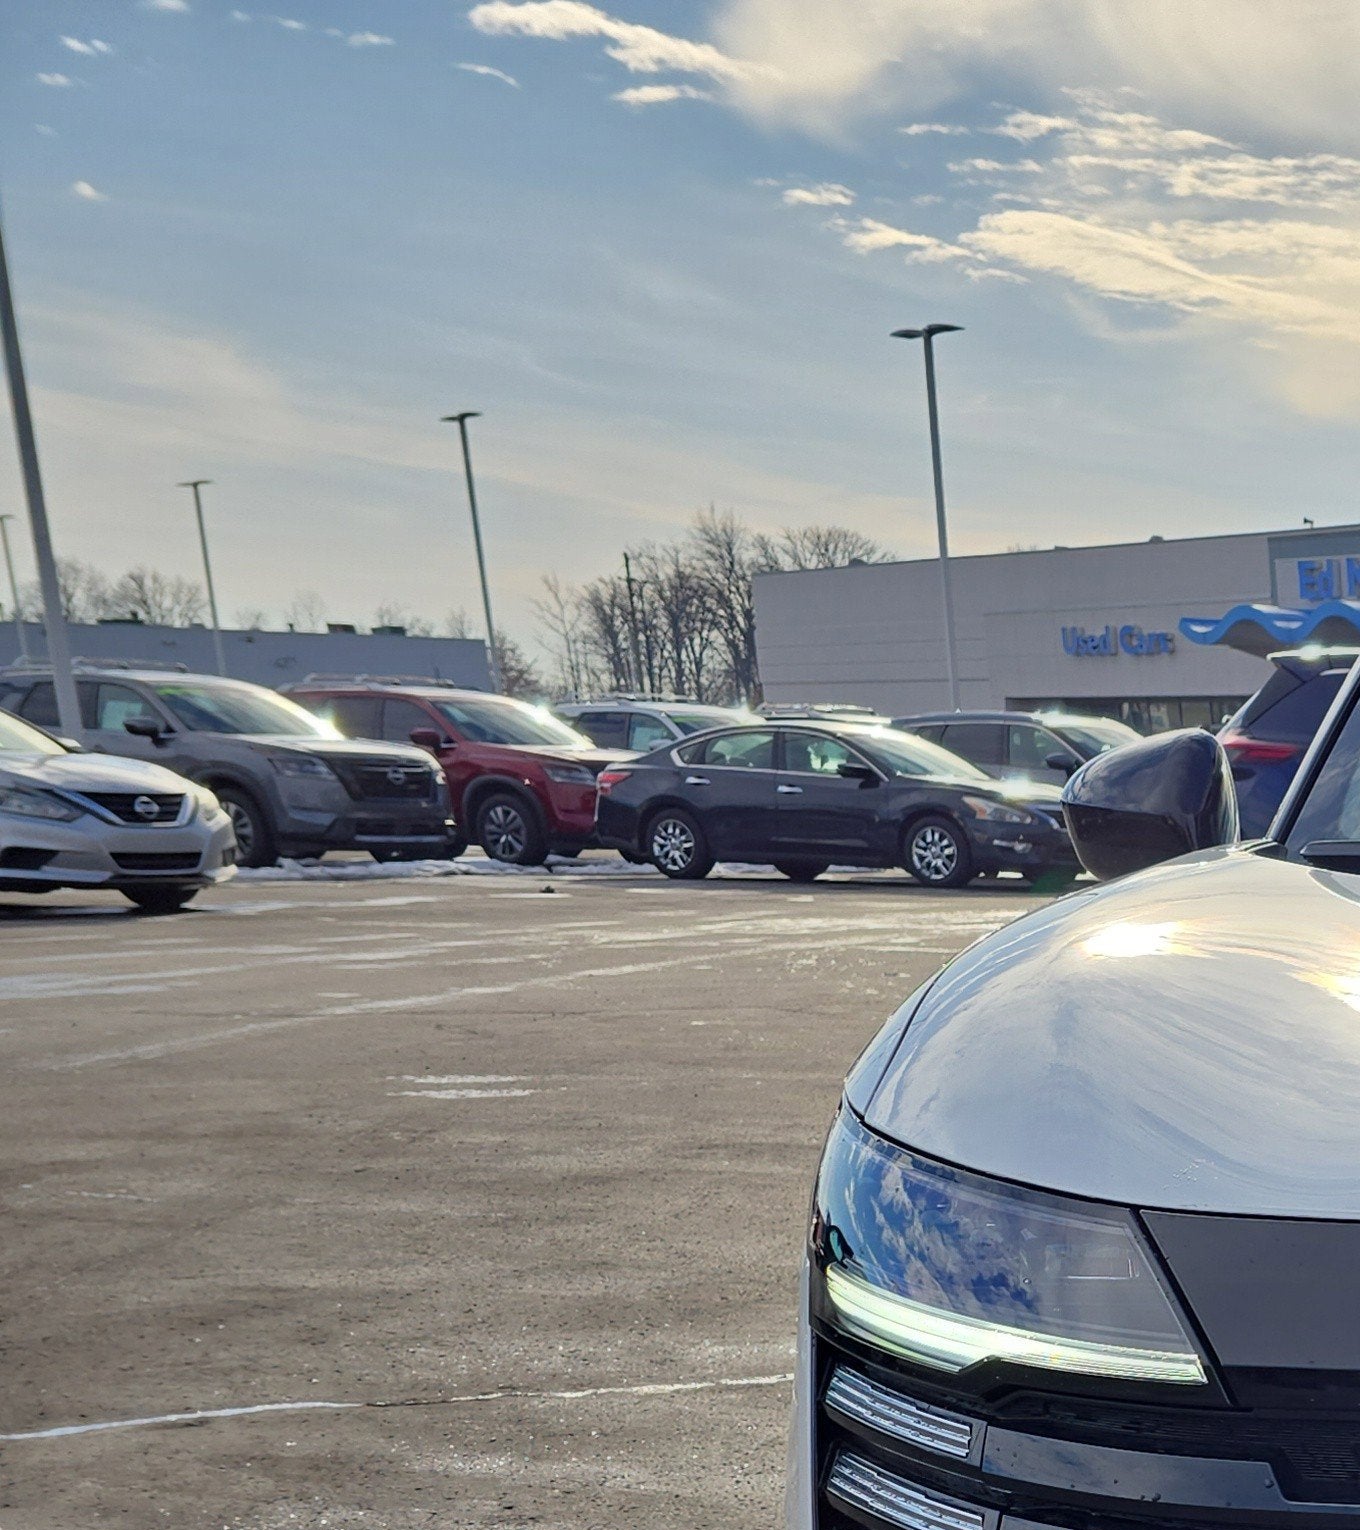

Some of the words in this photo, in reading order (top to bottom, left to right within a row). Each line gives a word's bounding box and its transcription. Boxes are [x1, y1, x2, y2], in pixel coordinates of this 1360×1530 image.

[1297, 558, 1333, 600] Ed
[1061, 625, 1113, 655] Used
[1119, 625, 1173, 655] Cars
